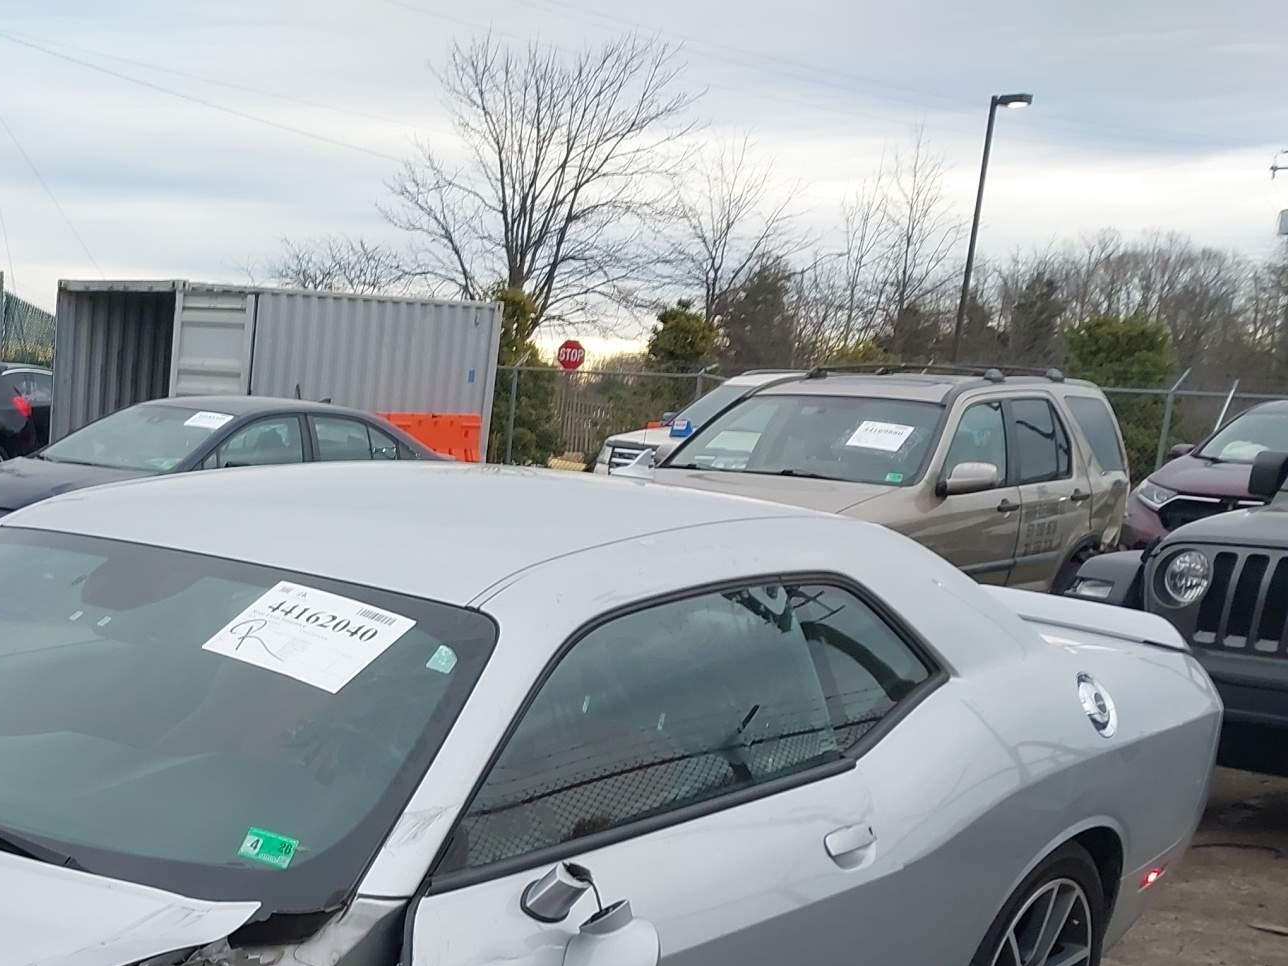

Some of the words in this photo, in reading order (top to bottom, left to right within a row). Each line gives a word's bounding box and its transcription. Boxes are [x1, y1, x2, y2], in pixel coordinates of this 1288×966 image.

[559, 348, 585, 362] STOP
[267, 600, 379, 642] 44162040
[250, 838, 261, 851] 4
